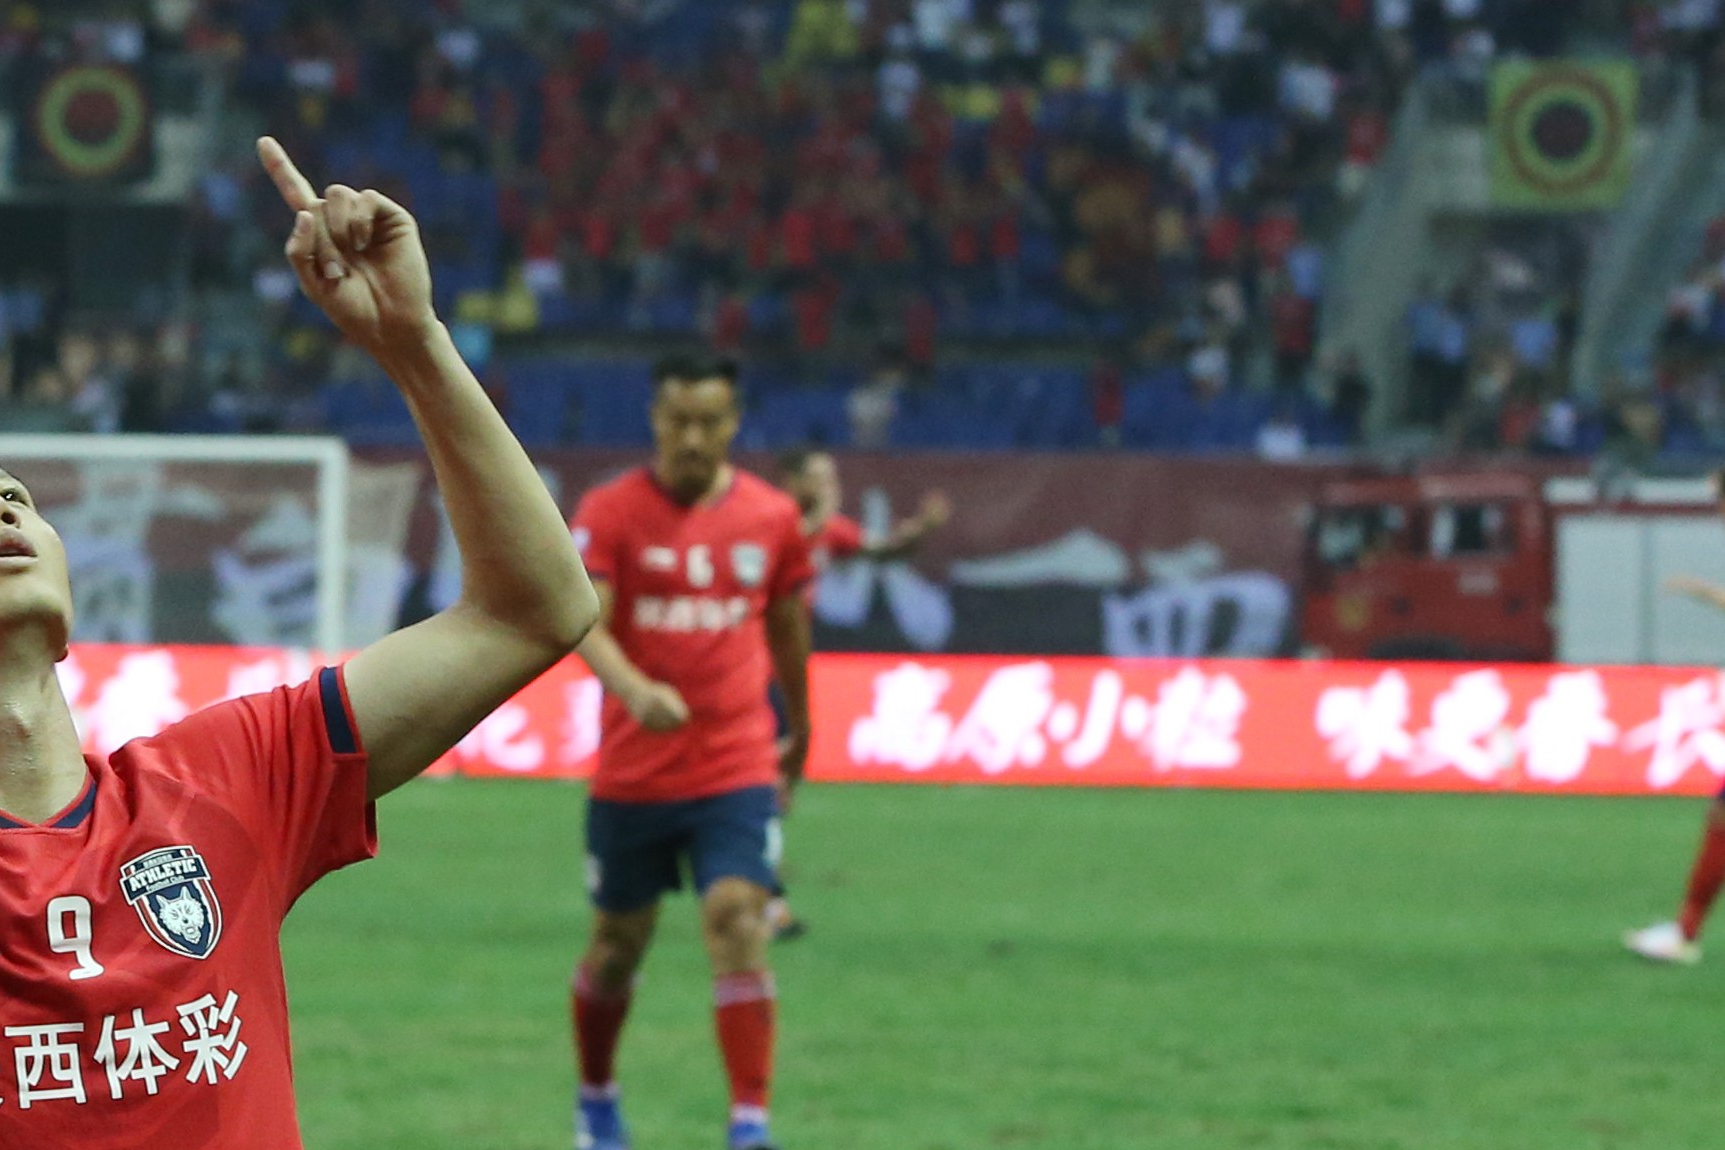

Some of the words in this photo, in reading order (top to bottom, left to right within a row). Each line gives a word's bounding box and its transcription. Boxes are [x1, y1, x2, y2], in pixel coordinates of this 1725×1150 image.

[685, 543, 715, 588] 6
[129, 859, 197, 892] ATHLETIC
[46, 895, 104, 980] 9
